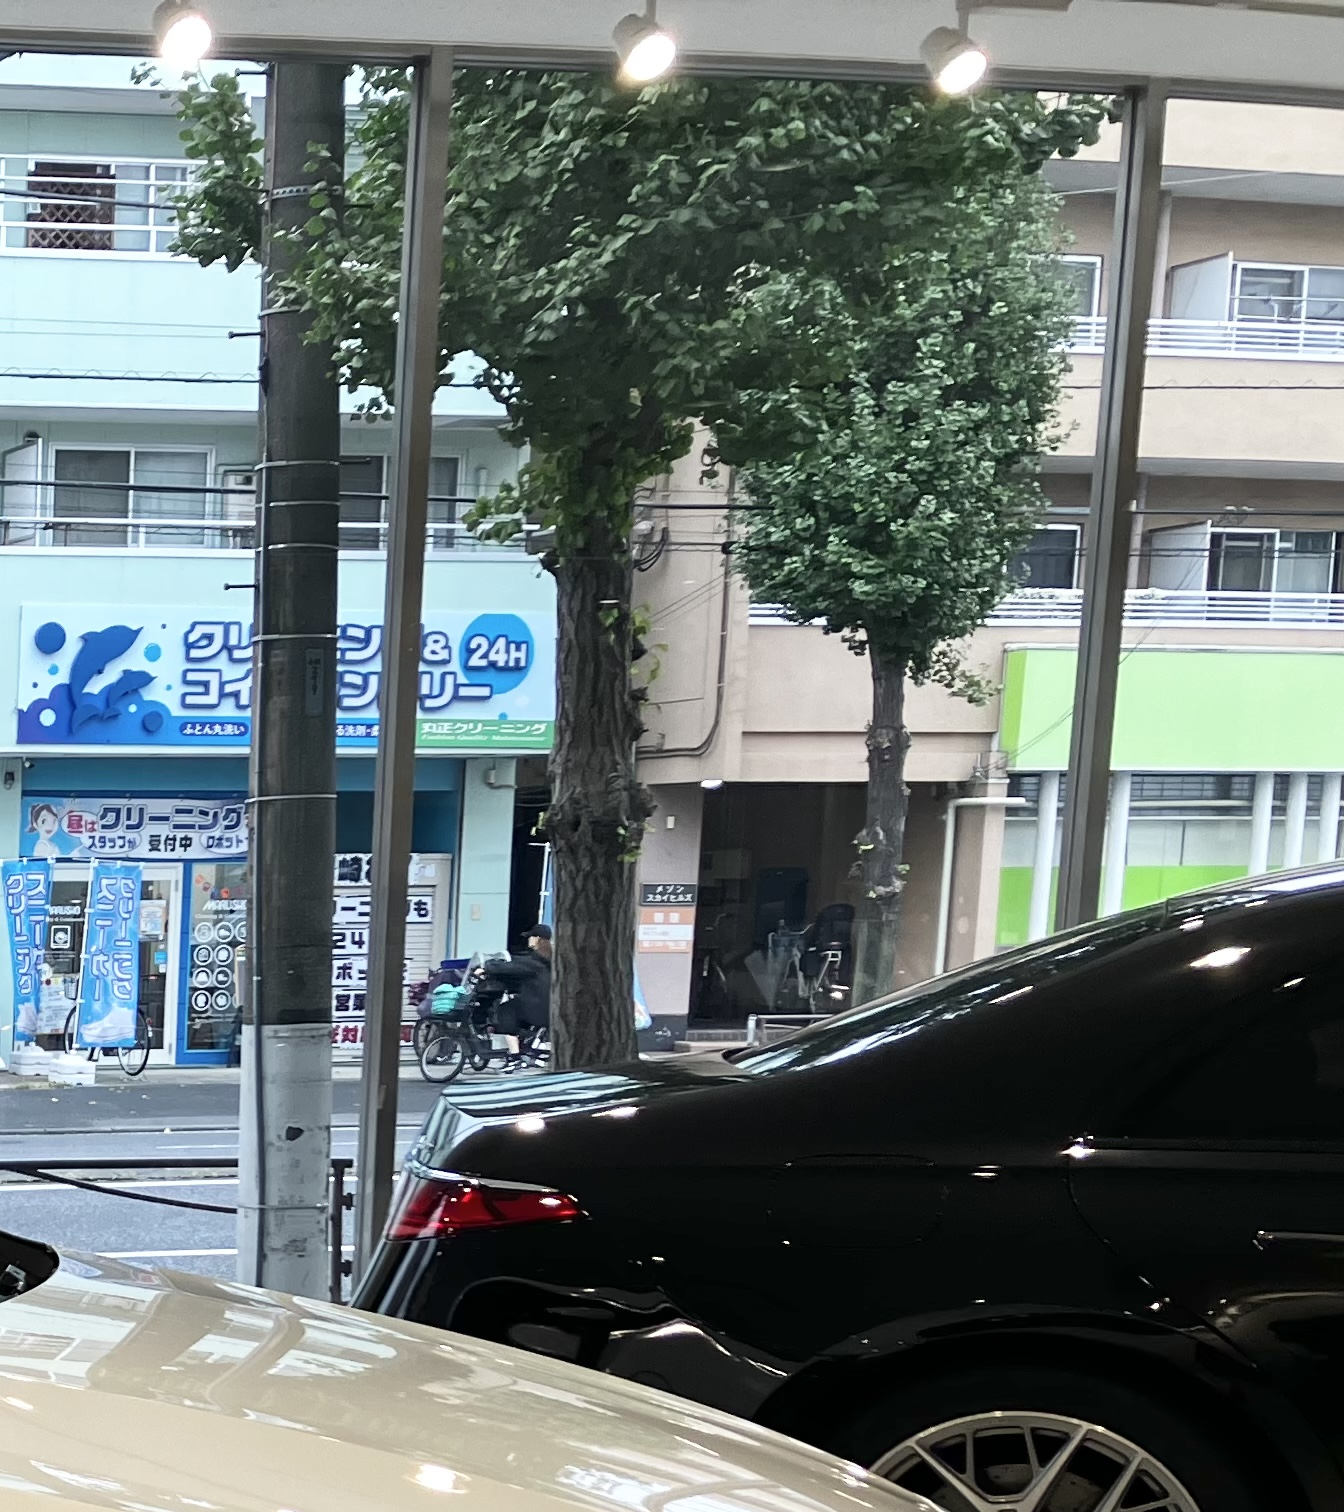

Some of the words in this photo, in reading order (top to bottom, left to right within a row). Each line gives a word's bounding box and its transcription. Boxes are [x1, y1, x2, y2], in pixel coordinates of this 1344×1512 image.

[467, 633, 528, 670] 24H
[183, 723, 245, 736] ふとん丸洗い
[421, 722, 548, 735] 丸正クリーニング
[147, 833, 193, 853] 受付中
[205, 835, 249, 849] ロボット
[645, 893, 694, 902] スカイヒルズ
[5, 873, 33, 996] クリーニング
